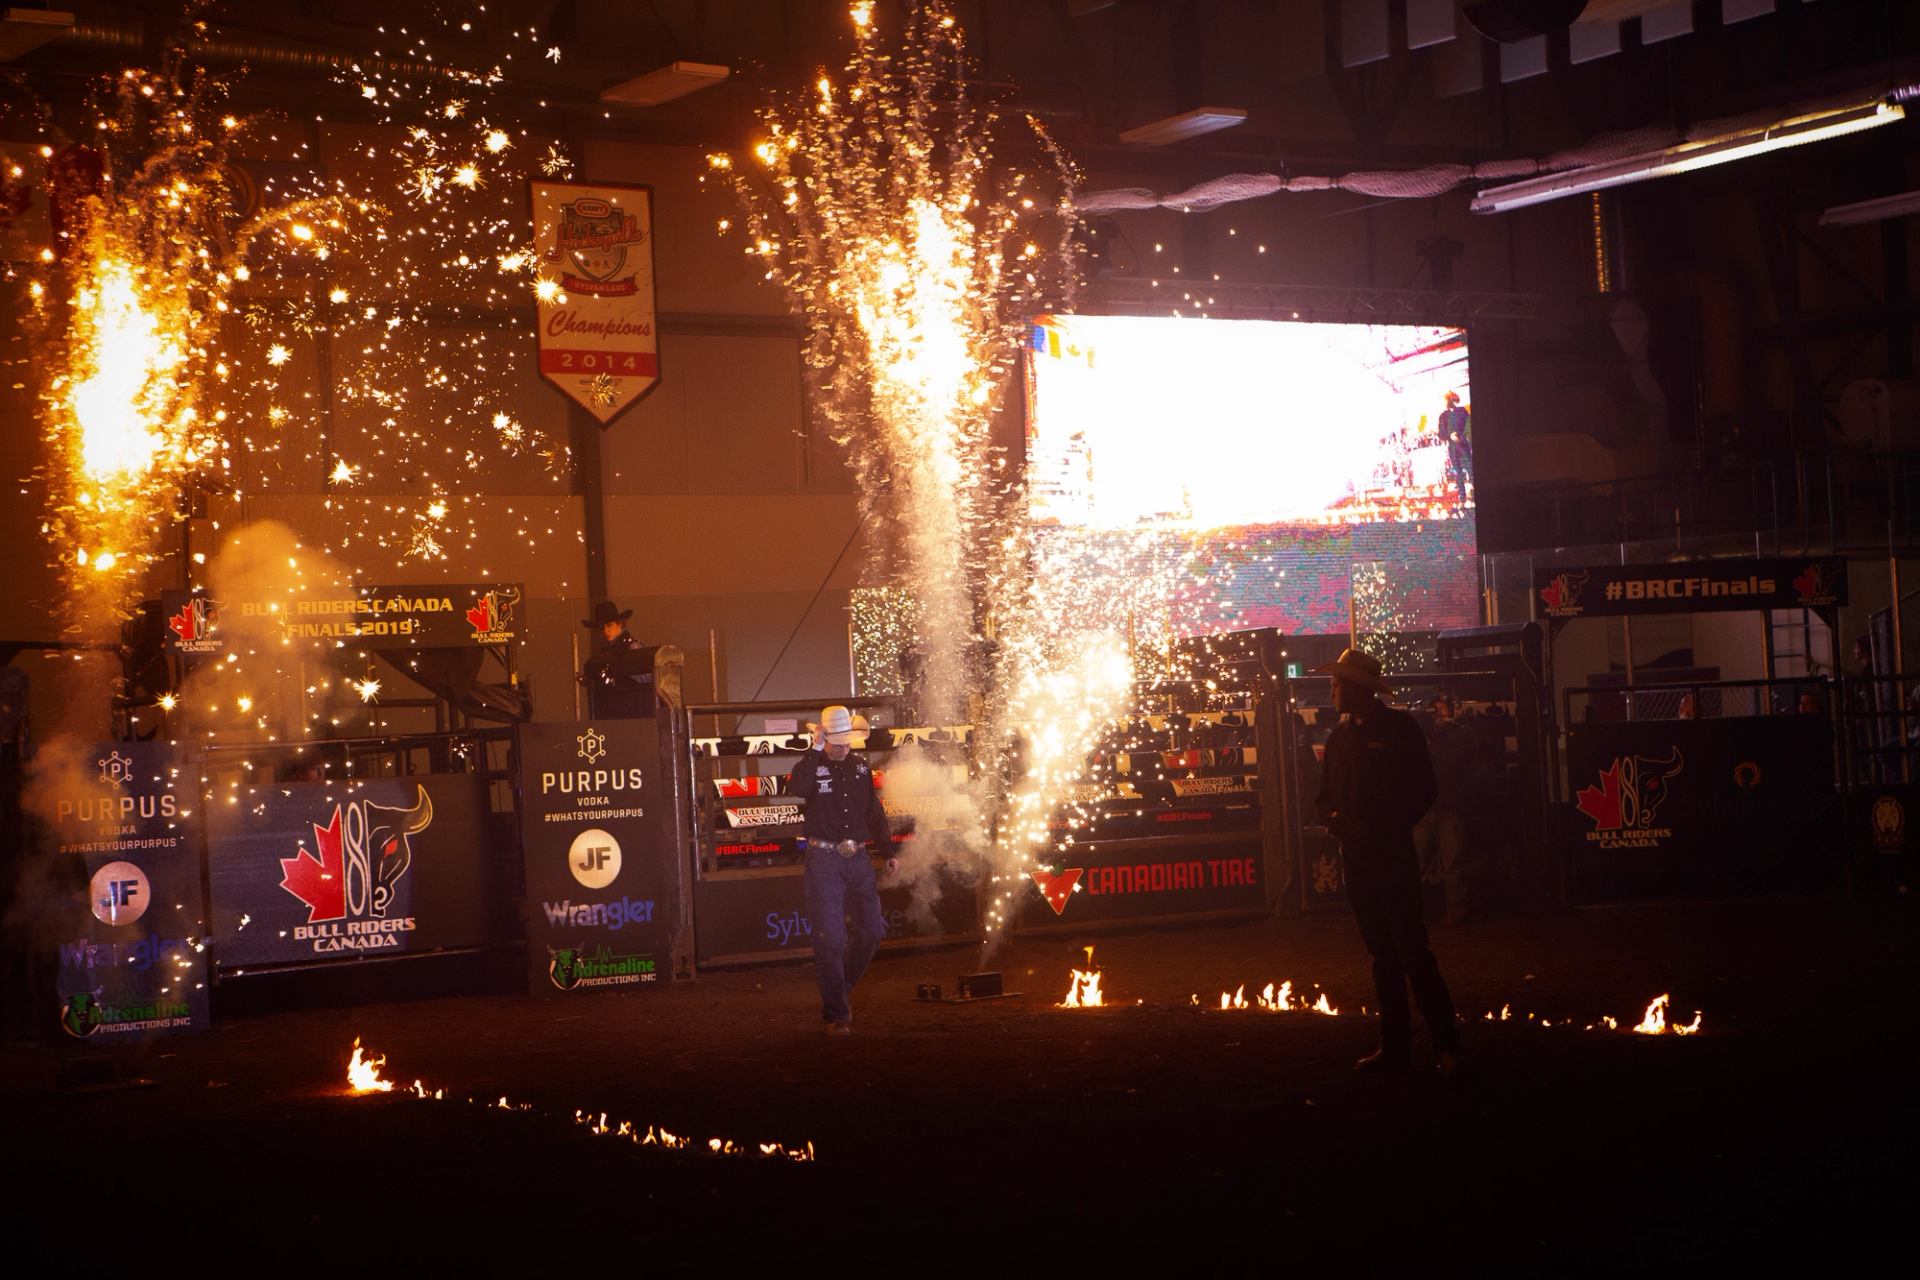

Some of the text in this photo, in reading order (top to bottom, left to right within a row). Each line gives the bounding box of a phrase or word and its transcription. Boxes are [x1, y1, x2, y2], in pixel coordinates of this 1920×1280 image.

[547, 310, 651, 340] Champions
[561, 353, 636, 370] 2014
[1606, 575, 1777, 601] #BRCFinals
[241, 598, 454, 617] BULL RIDERS CANADA
[287, 620, 413, 638] FINALS 2019
[542, 768, 642, 794] PURPUS
[57, 794, 176, 823] PURPUS
[577, 796, 610, 807] VODKA
[544, 808, 643, 822] #WHATSYOURPURPUS
[98, 825, 137, 836] VODKA
[1586, 828, 1672, 841] BULL RIDERS
[59, 838, 177, 853] #WHATSYOURPURPUS
[1600, 838, 1659, 848] CANADA
[578, 846, 612, 872] JF
[1088, 858, 1256, 895] CANADIAN TIRE
[100, 880, 138, 907] JF
[542, 896, 655, 931] Wrangler
[293, 917, 417, 940] BULL RIDERS
[313, 933, 399, 953] CANADA
[573, 957, 656, 978] Adrenaline
[581, 973, 656, 987] PRODUCTIONS INC
[88, 1001, 190, 1025] Adrenaline
[99, 1016, 193, 1033] PRODUCTIONS INC
